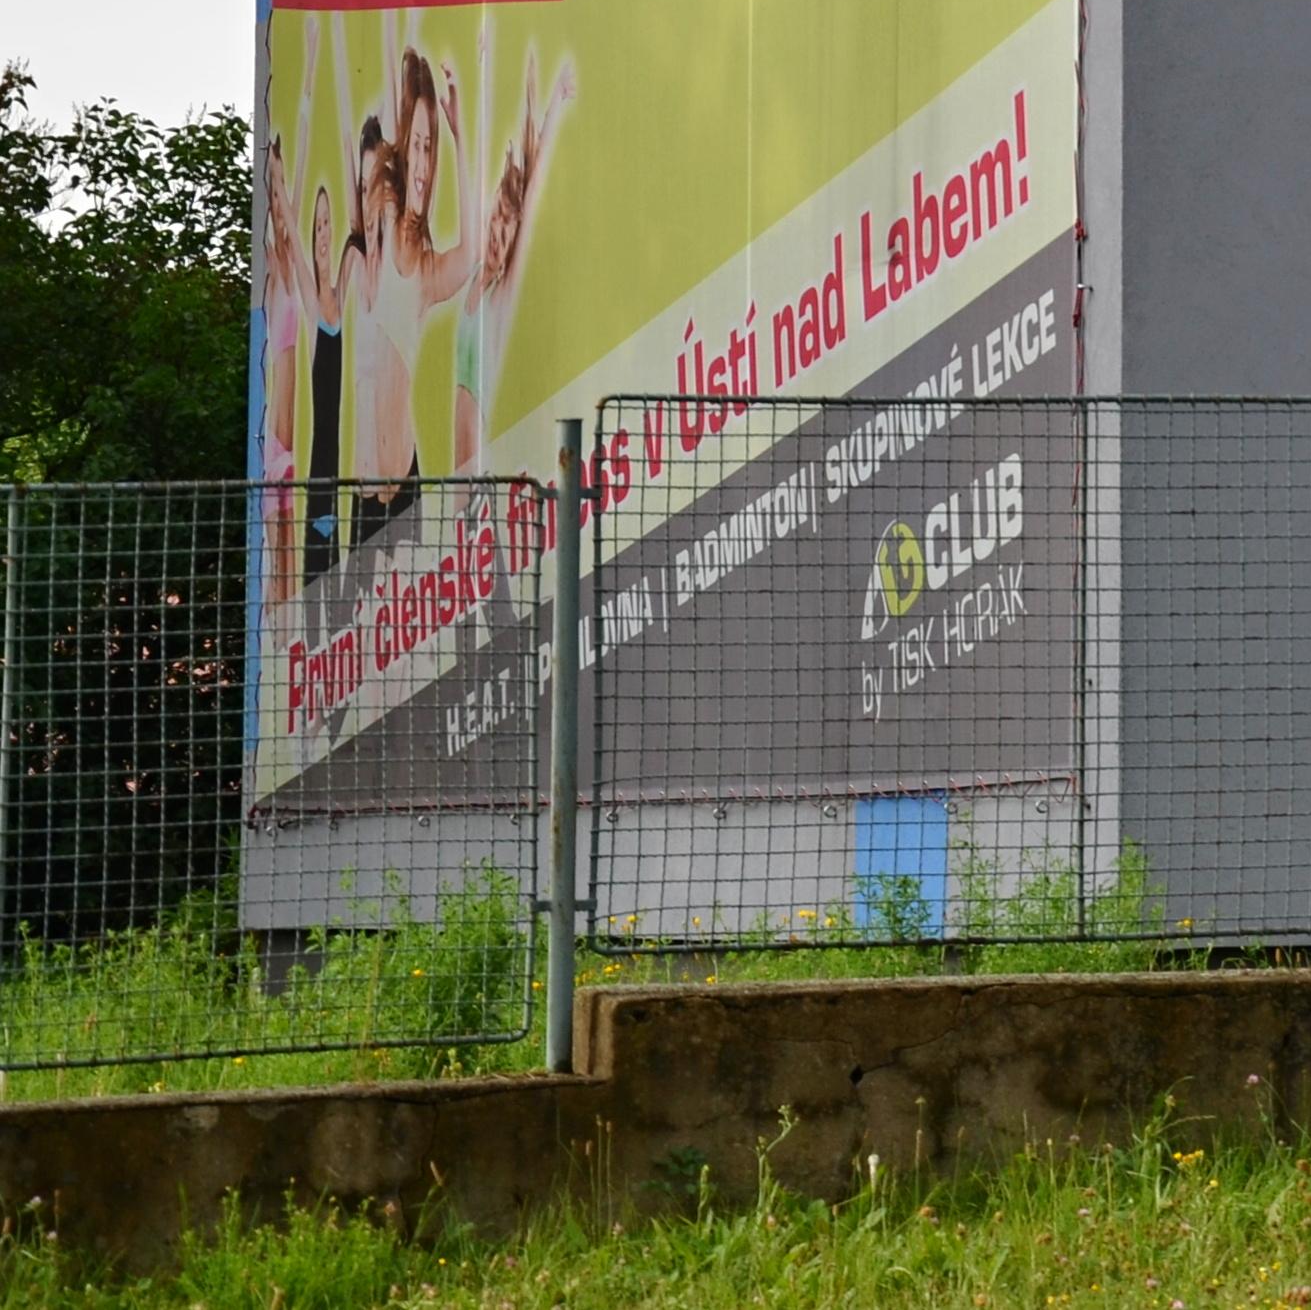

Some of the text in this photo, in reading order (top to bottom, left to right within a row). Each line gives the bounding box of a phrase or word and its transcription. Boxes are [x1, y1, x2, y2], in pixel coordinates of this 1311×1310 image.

[288, 596, 363, 735] První
[374, 505, 495, 672] členské
[677, 299, 757, 453] Ústí
[773, 233, 846, 388] nad
[860, 89, 1029, 322] Labem!
[538, 576, 653, 696] PILOVNA
[675, 467, 808, 607] BADMINTON
[825, 343, 964, 503] SKUPINOVÉ
[971, 289, 1057, 397] LEKCE
[862, 660, 883, 724] by
[888, 616, 936, 692] TISK
